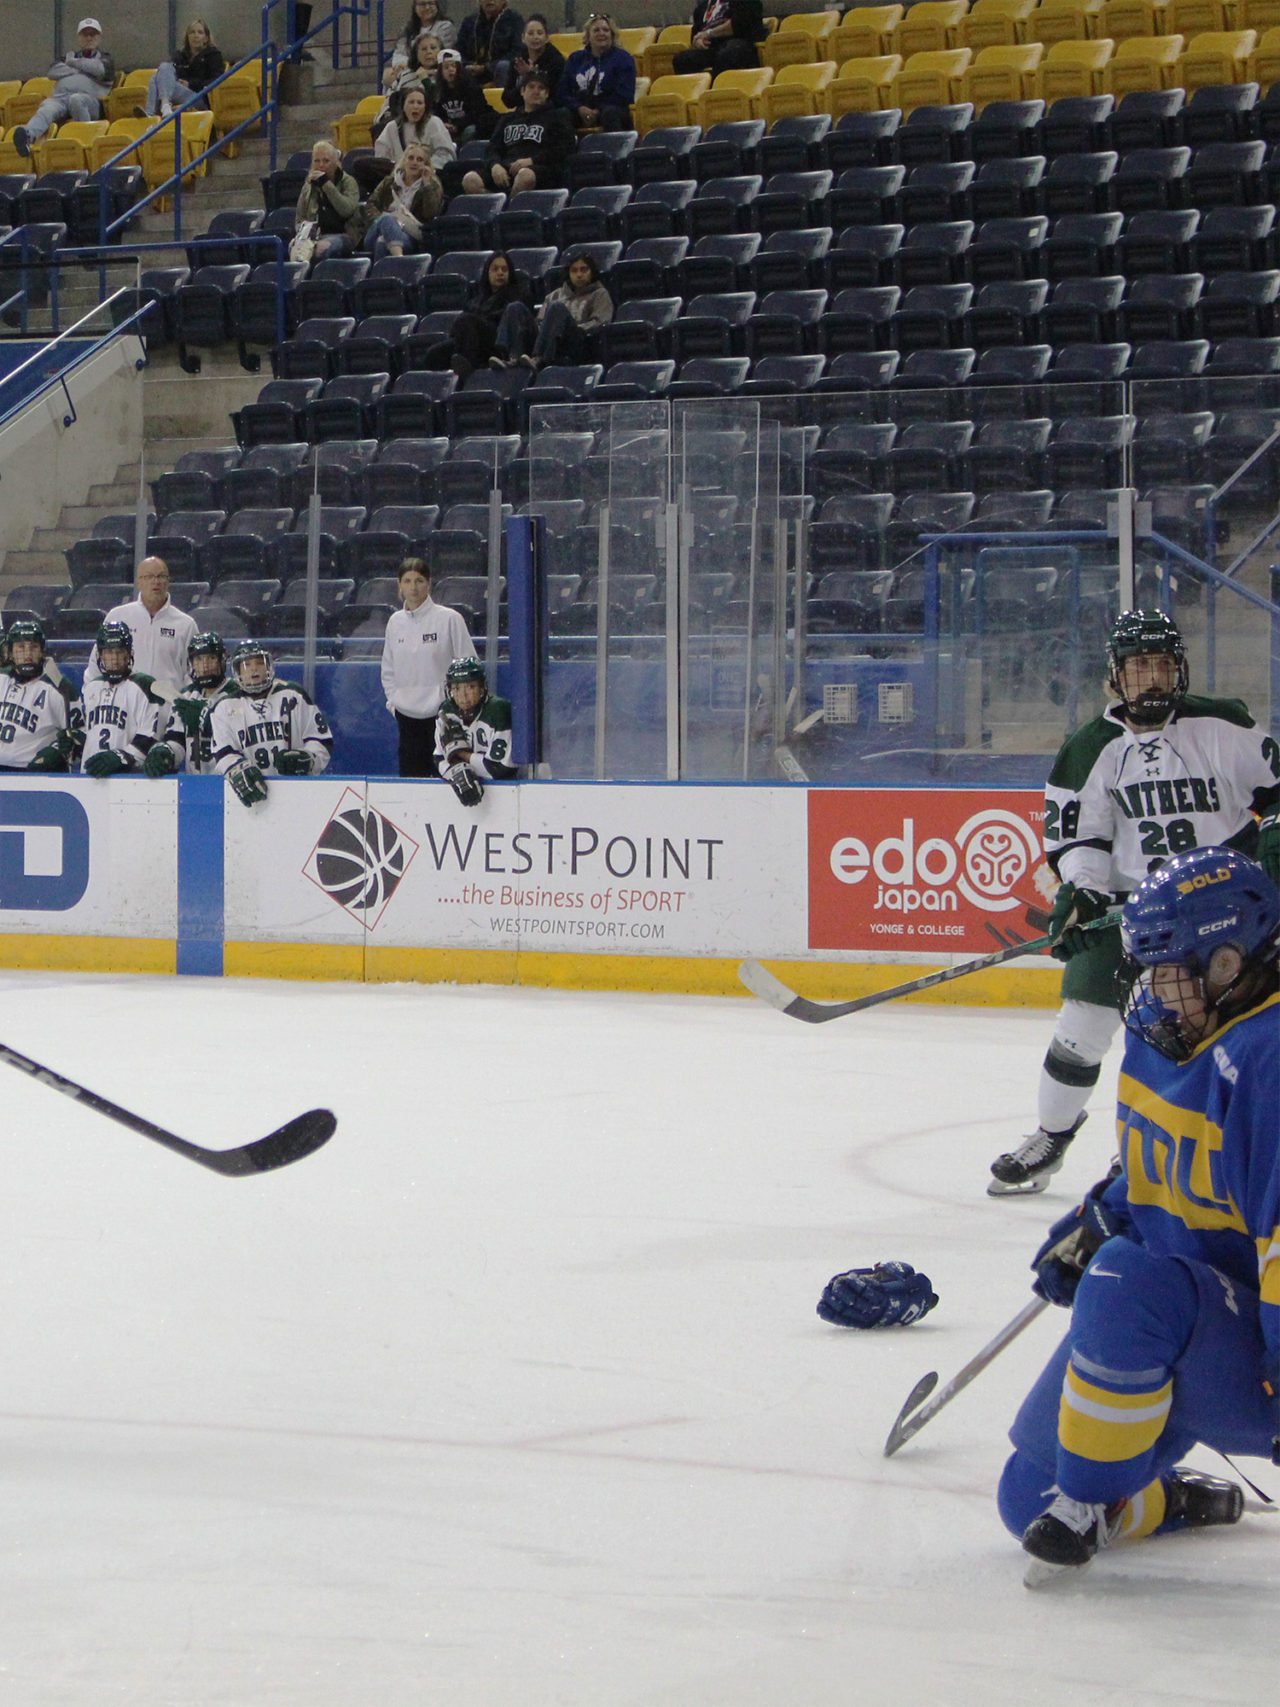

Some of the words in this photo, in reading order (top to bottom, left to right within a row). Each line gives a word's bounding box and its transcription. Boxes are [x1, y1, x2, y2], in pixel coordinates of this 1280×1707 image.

[503, 124, 544, 143] UPEI
[33, 690, 47, 709] A
[99, 728, 111, 750] 2
[1138, 819, 1197, 857] 28
[830, 818, 957, 886] edo
[1176, 868, 1232, 895] BOLD
[500, 885, 584, 909] Business
[590, 888, 612, 915] of
[617, 889, 686, 912] SPORT
[873, 885, 957, 914] japan
[490, 917, 665, 939] WESTPOINTSPORT.COM
[870, 923, 904, 935] YONGE
[907, 924, 915, 935] &
[917, 924, 965, 937] COLLEGE
[1198, 916, 1237, 936] CCM
